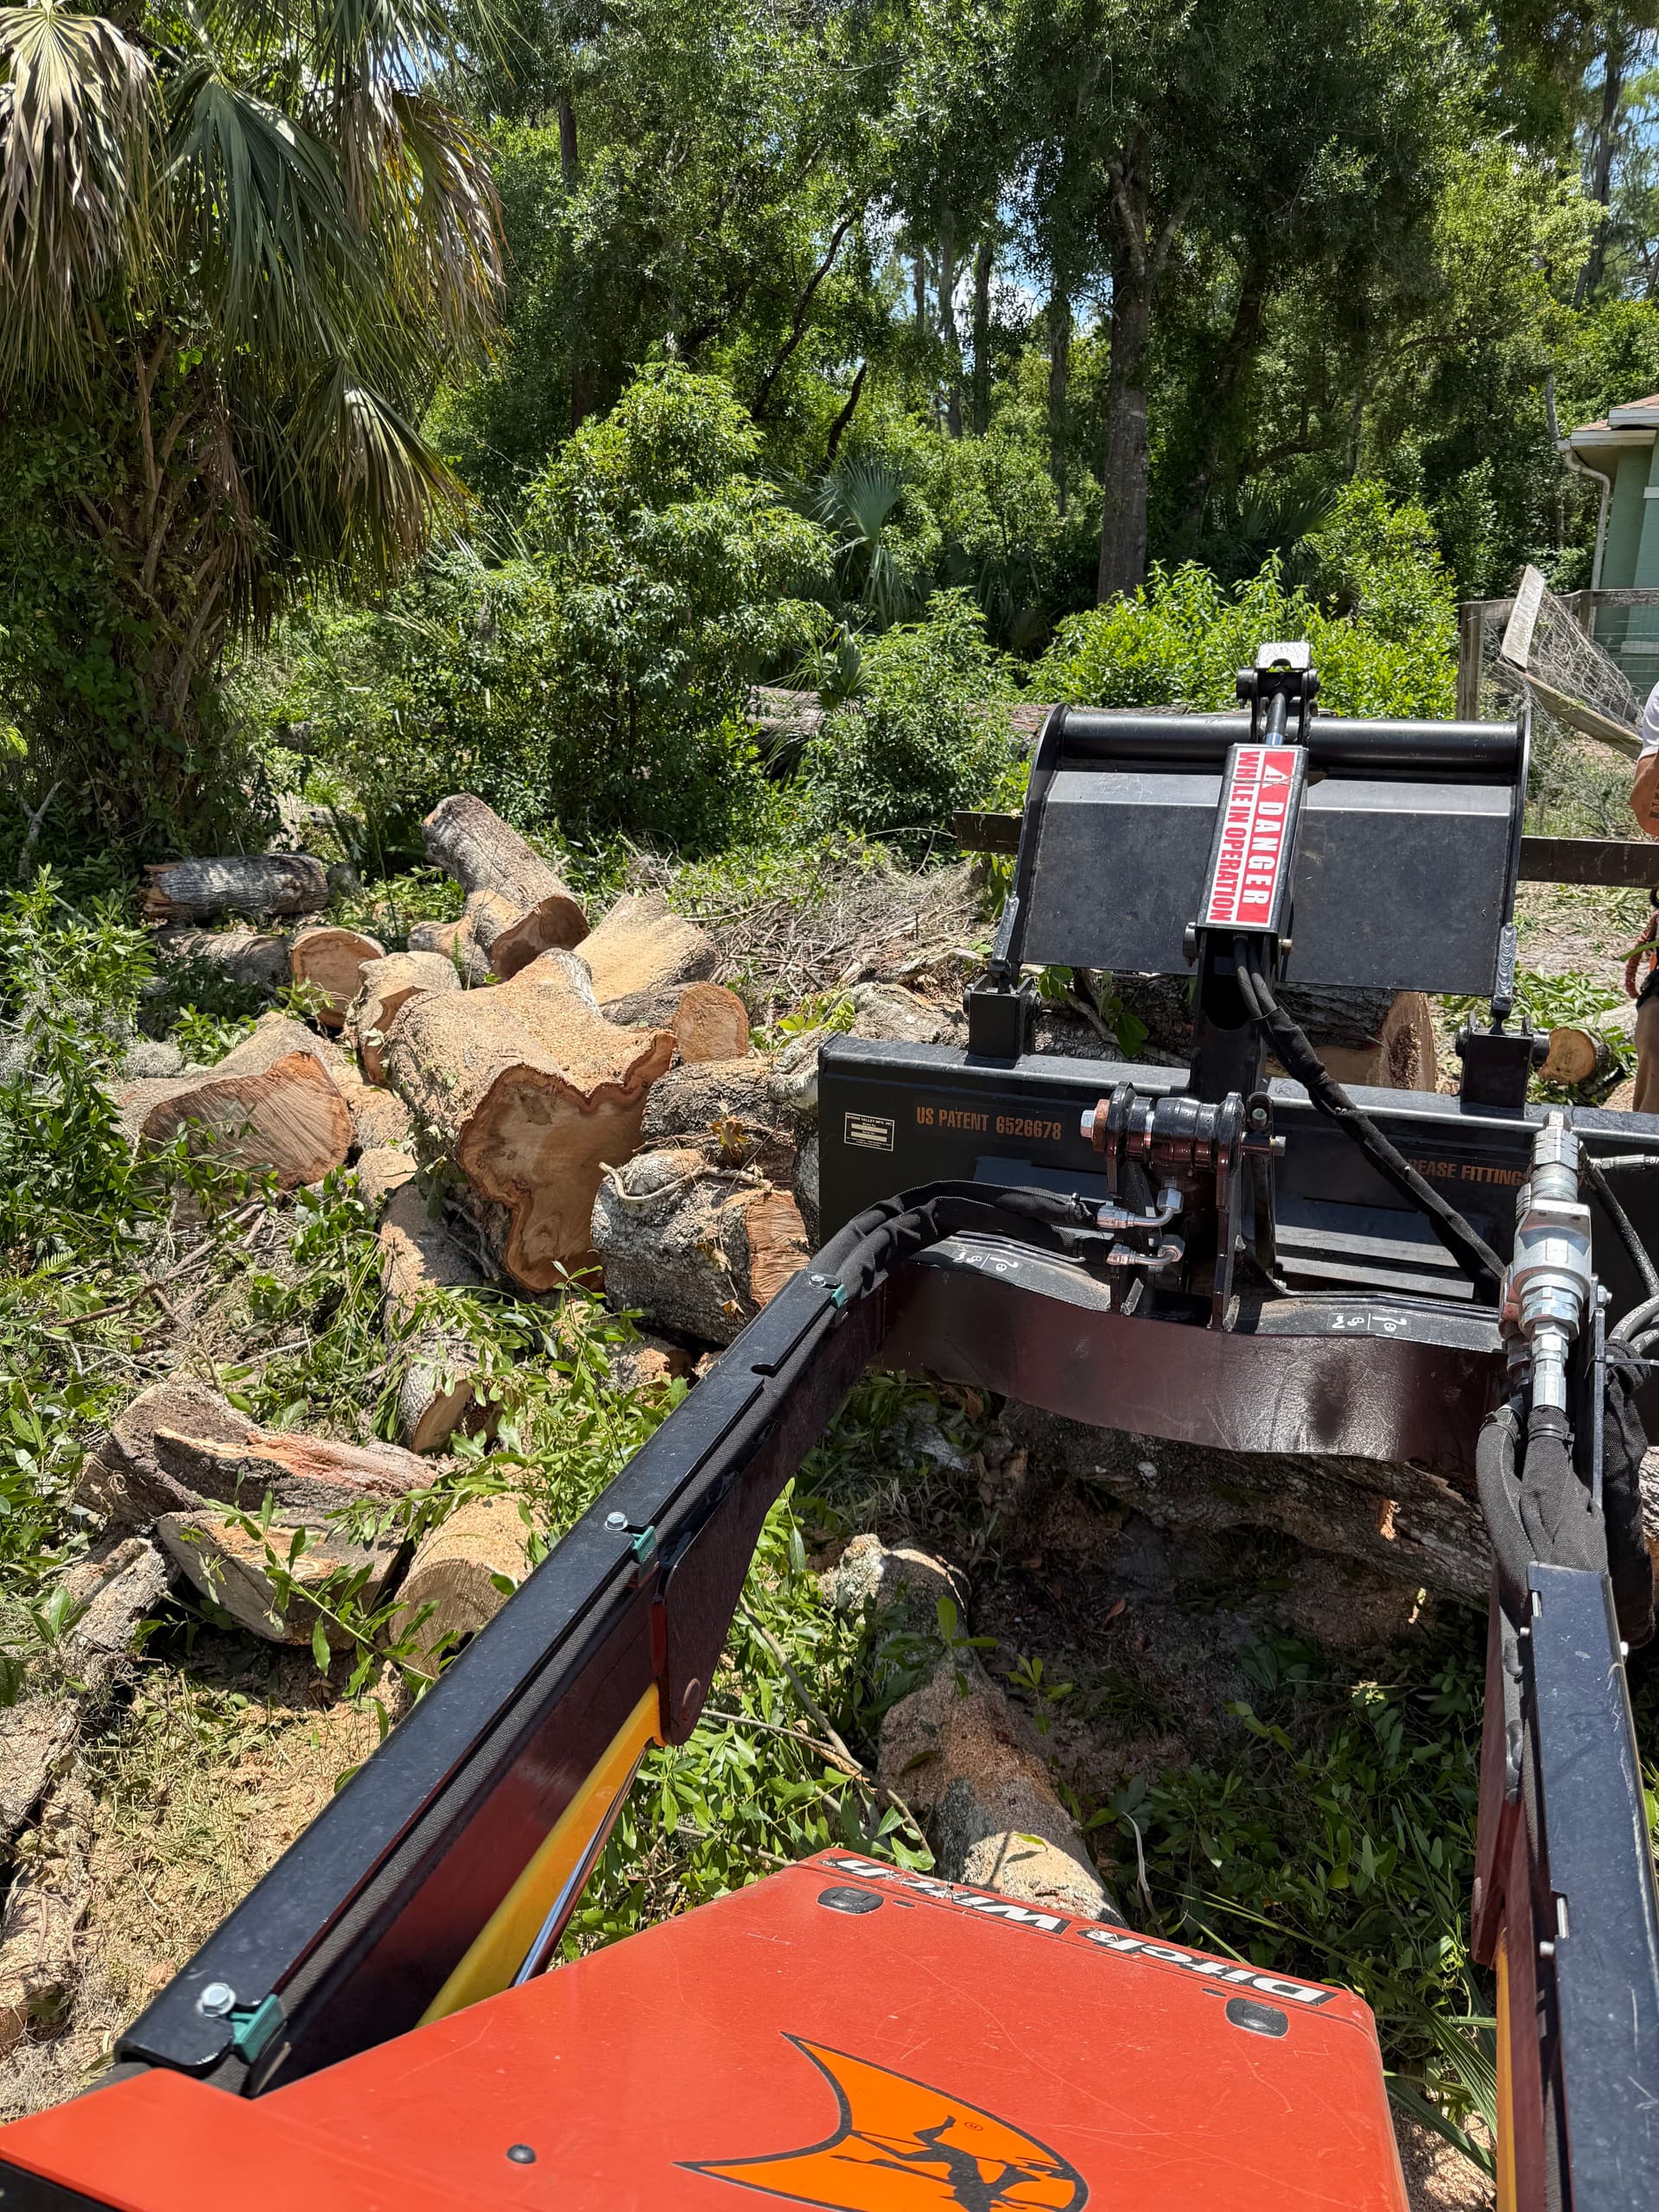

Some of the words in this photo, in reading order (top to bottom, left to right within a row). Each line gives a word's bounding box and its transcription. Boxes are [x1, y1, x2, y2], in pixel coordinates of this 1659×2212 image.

[1231, 751, 1261, 802] WHILE
[1228, 806, 1251, 823] IN
[1210, 827, 1248, 922] OPERATION
[1243, 801, 1285, 905] DANGER
[916, 1107, 935, 1125] US
[938, 1109, 989, 1132] PATENT
[995, 1116, 1062, 1140] 6526678
[1407, 1159, 1457, 1179] REASE
[1086, 1928, 1326, 2003] Ditch
